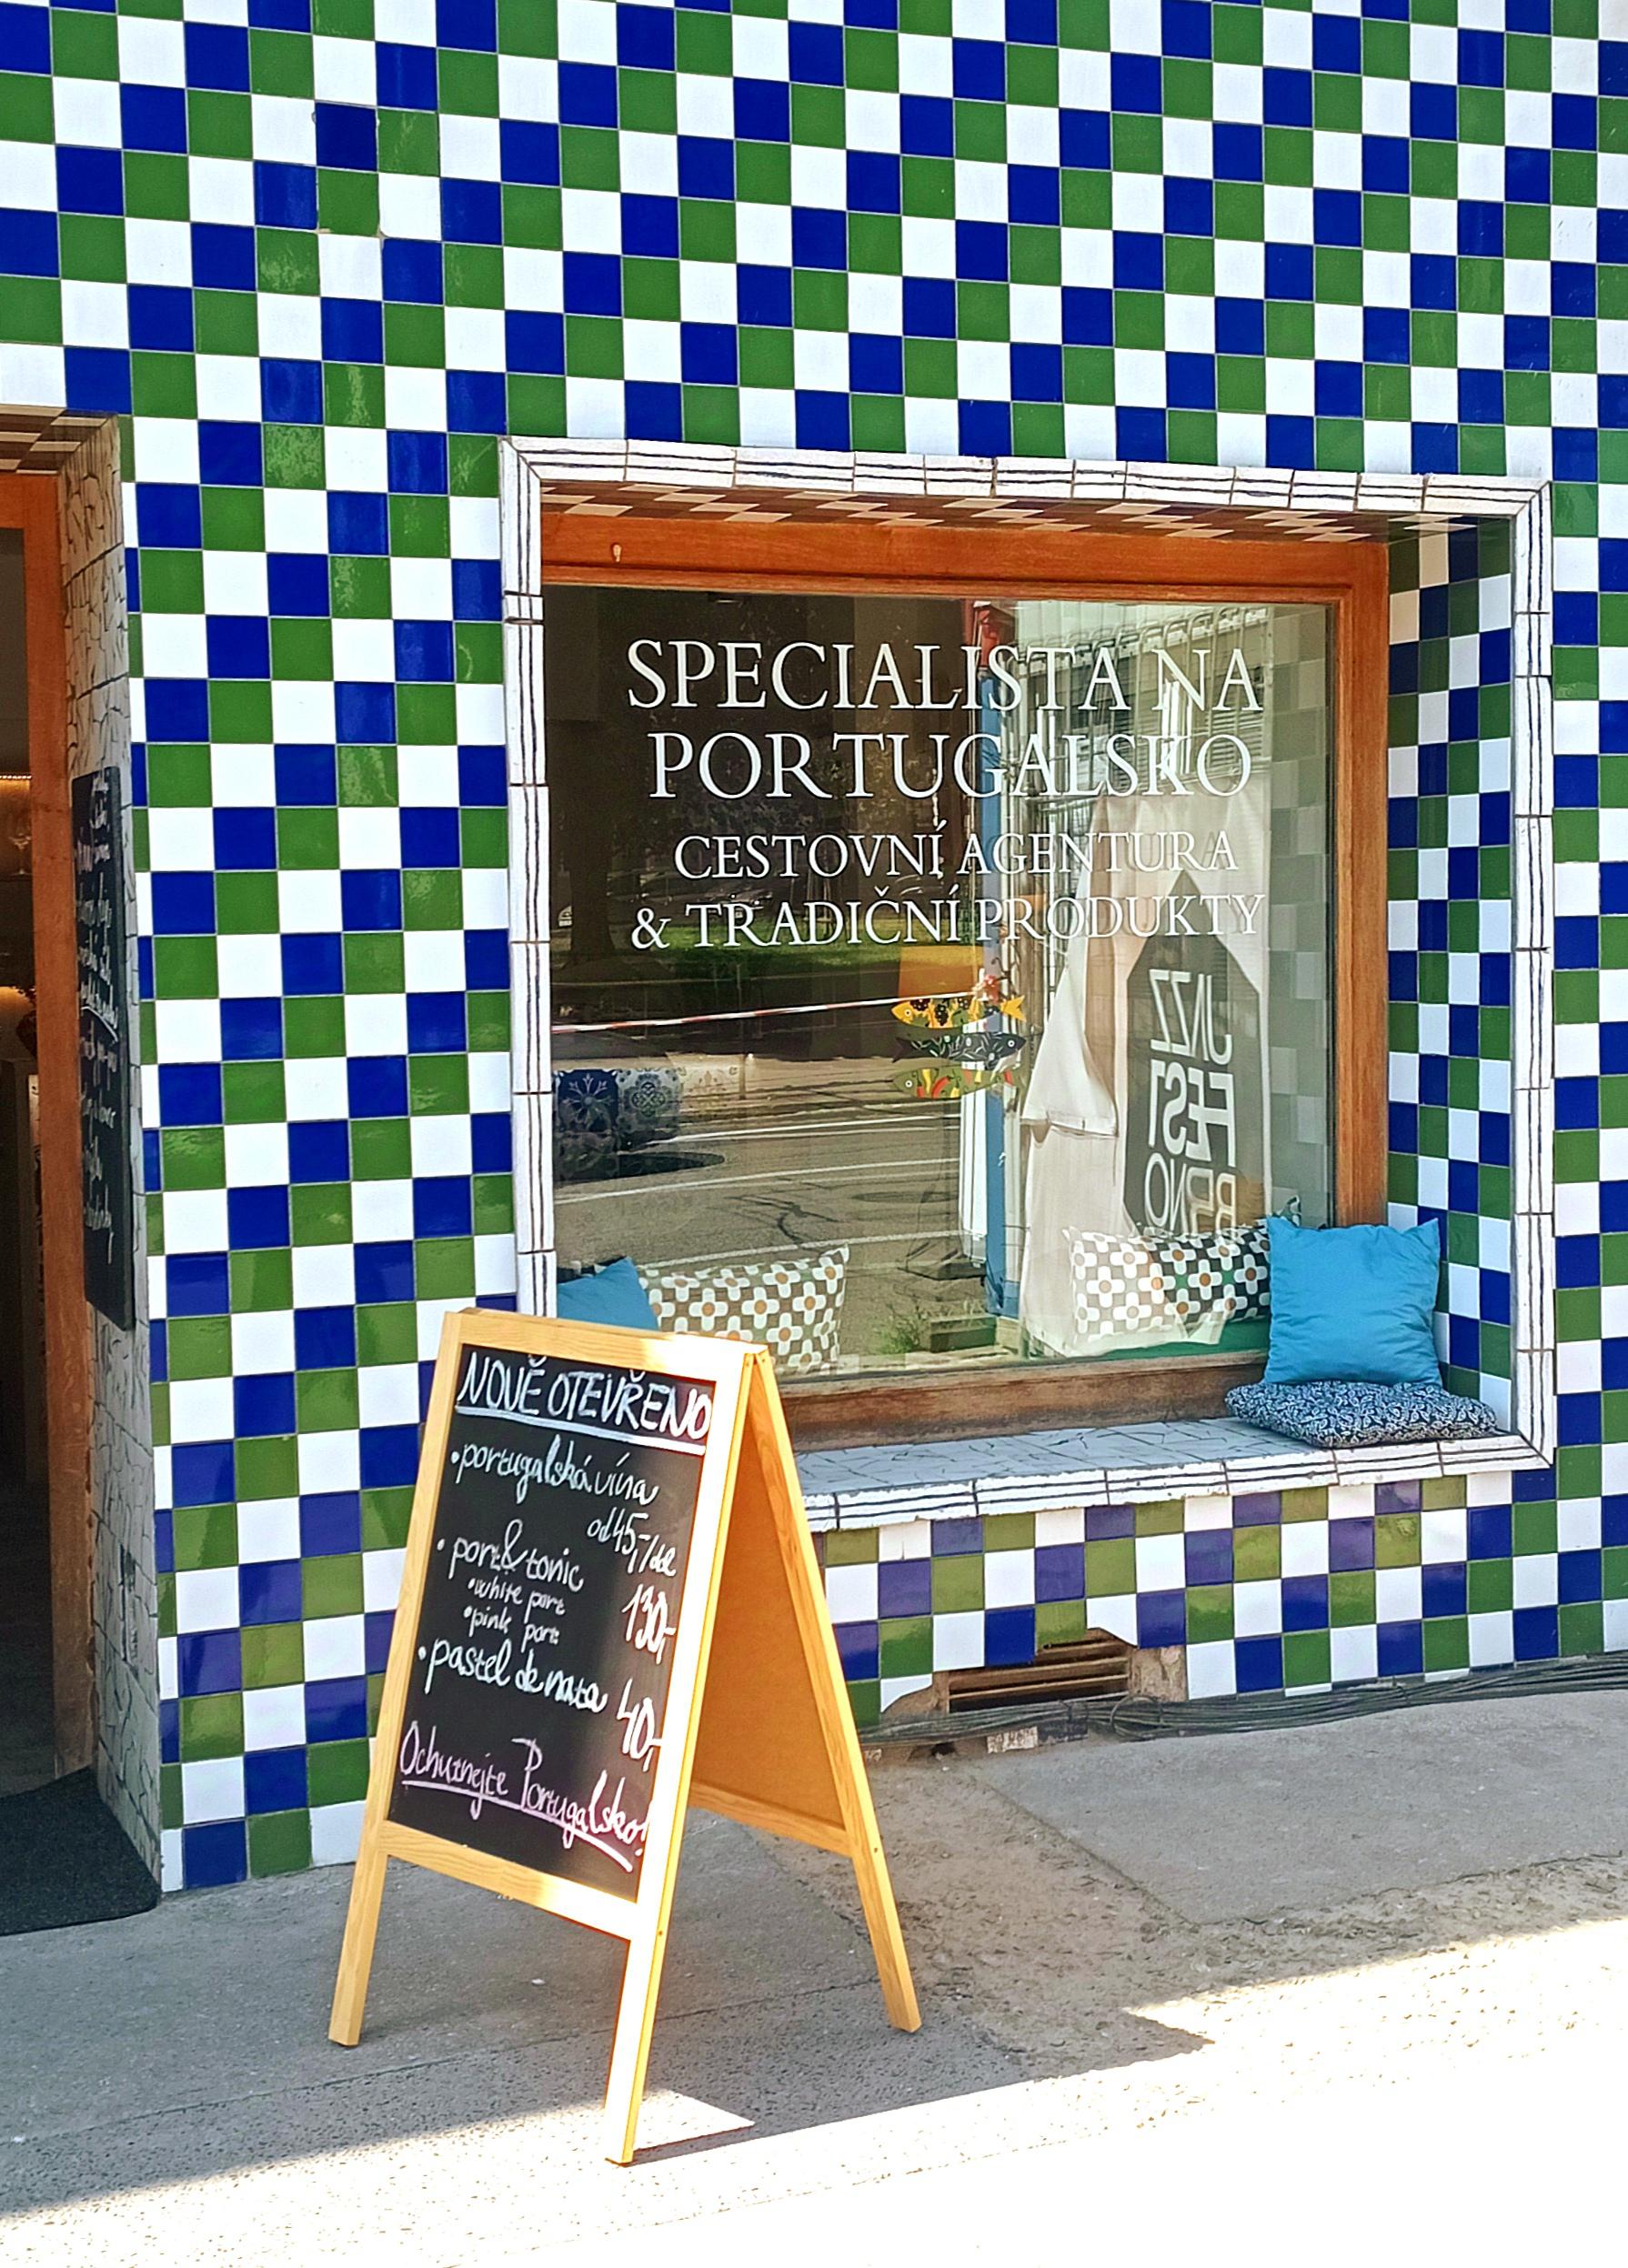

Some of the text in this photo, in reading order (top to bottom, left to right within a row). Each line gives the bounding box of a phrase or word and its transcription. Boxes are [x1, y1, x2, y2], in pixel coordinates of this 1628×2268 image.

[627, 639, 1264, 712] SPECIALISTA NA
[647, 730, 1252, 799] PORTUGALSKO
[673, 819, 1240, 879] CESTOVNÍ AGENTURA
[630, 886, 1266, 949] & TRADIČNÍ PRODUKTY
[457, 1351, 712, 1440] NOVĚ OTEVŘENO
[455, 1434, 593, 1504] portugalská
[473, 1575, 523, 1605] white
[525, 1548, 584, 1591] tonic
[468, 1606, 512, 1638] pink
[424, 1638, 512, 1695] pastel
